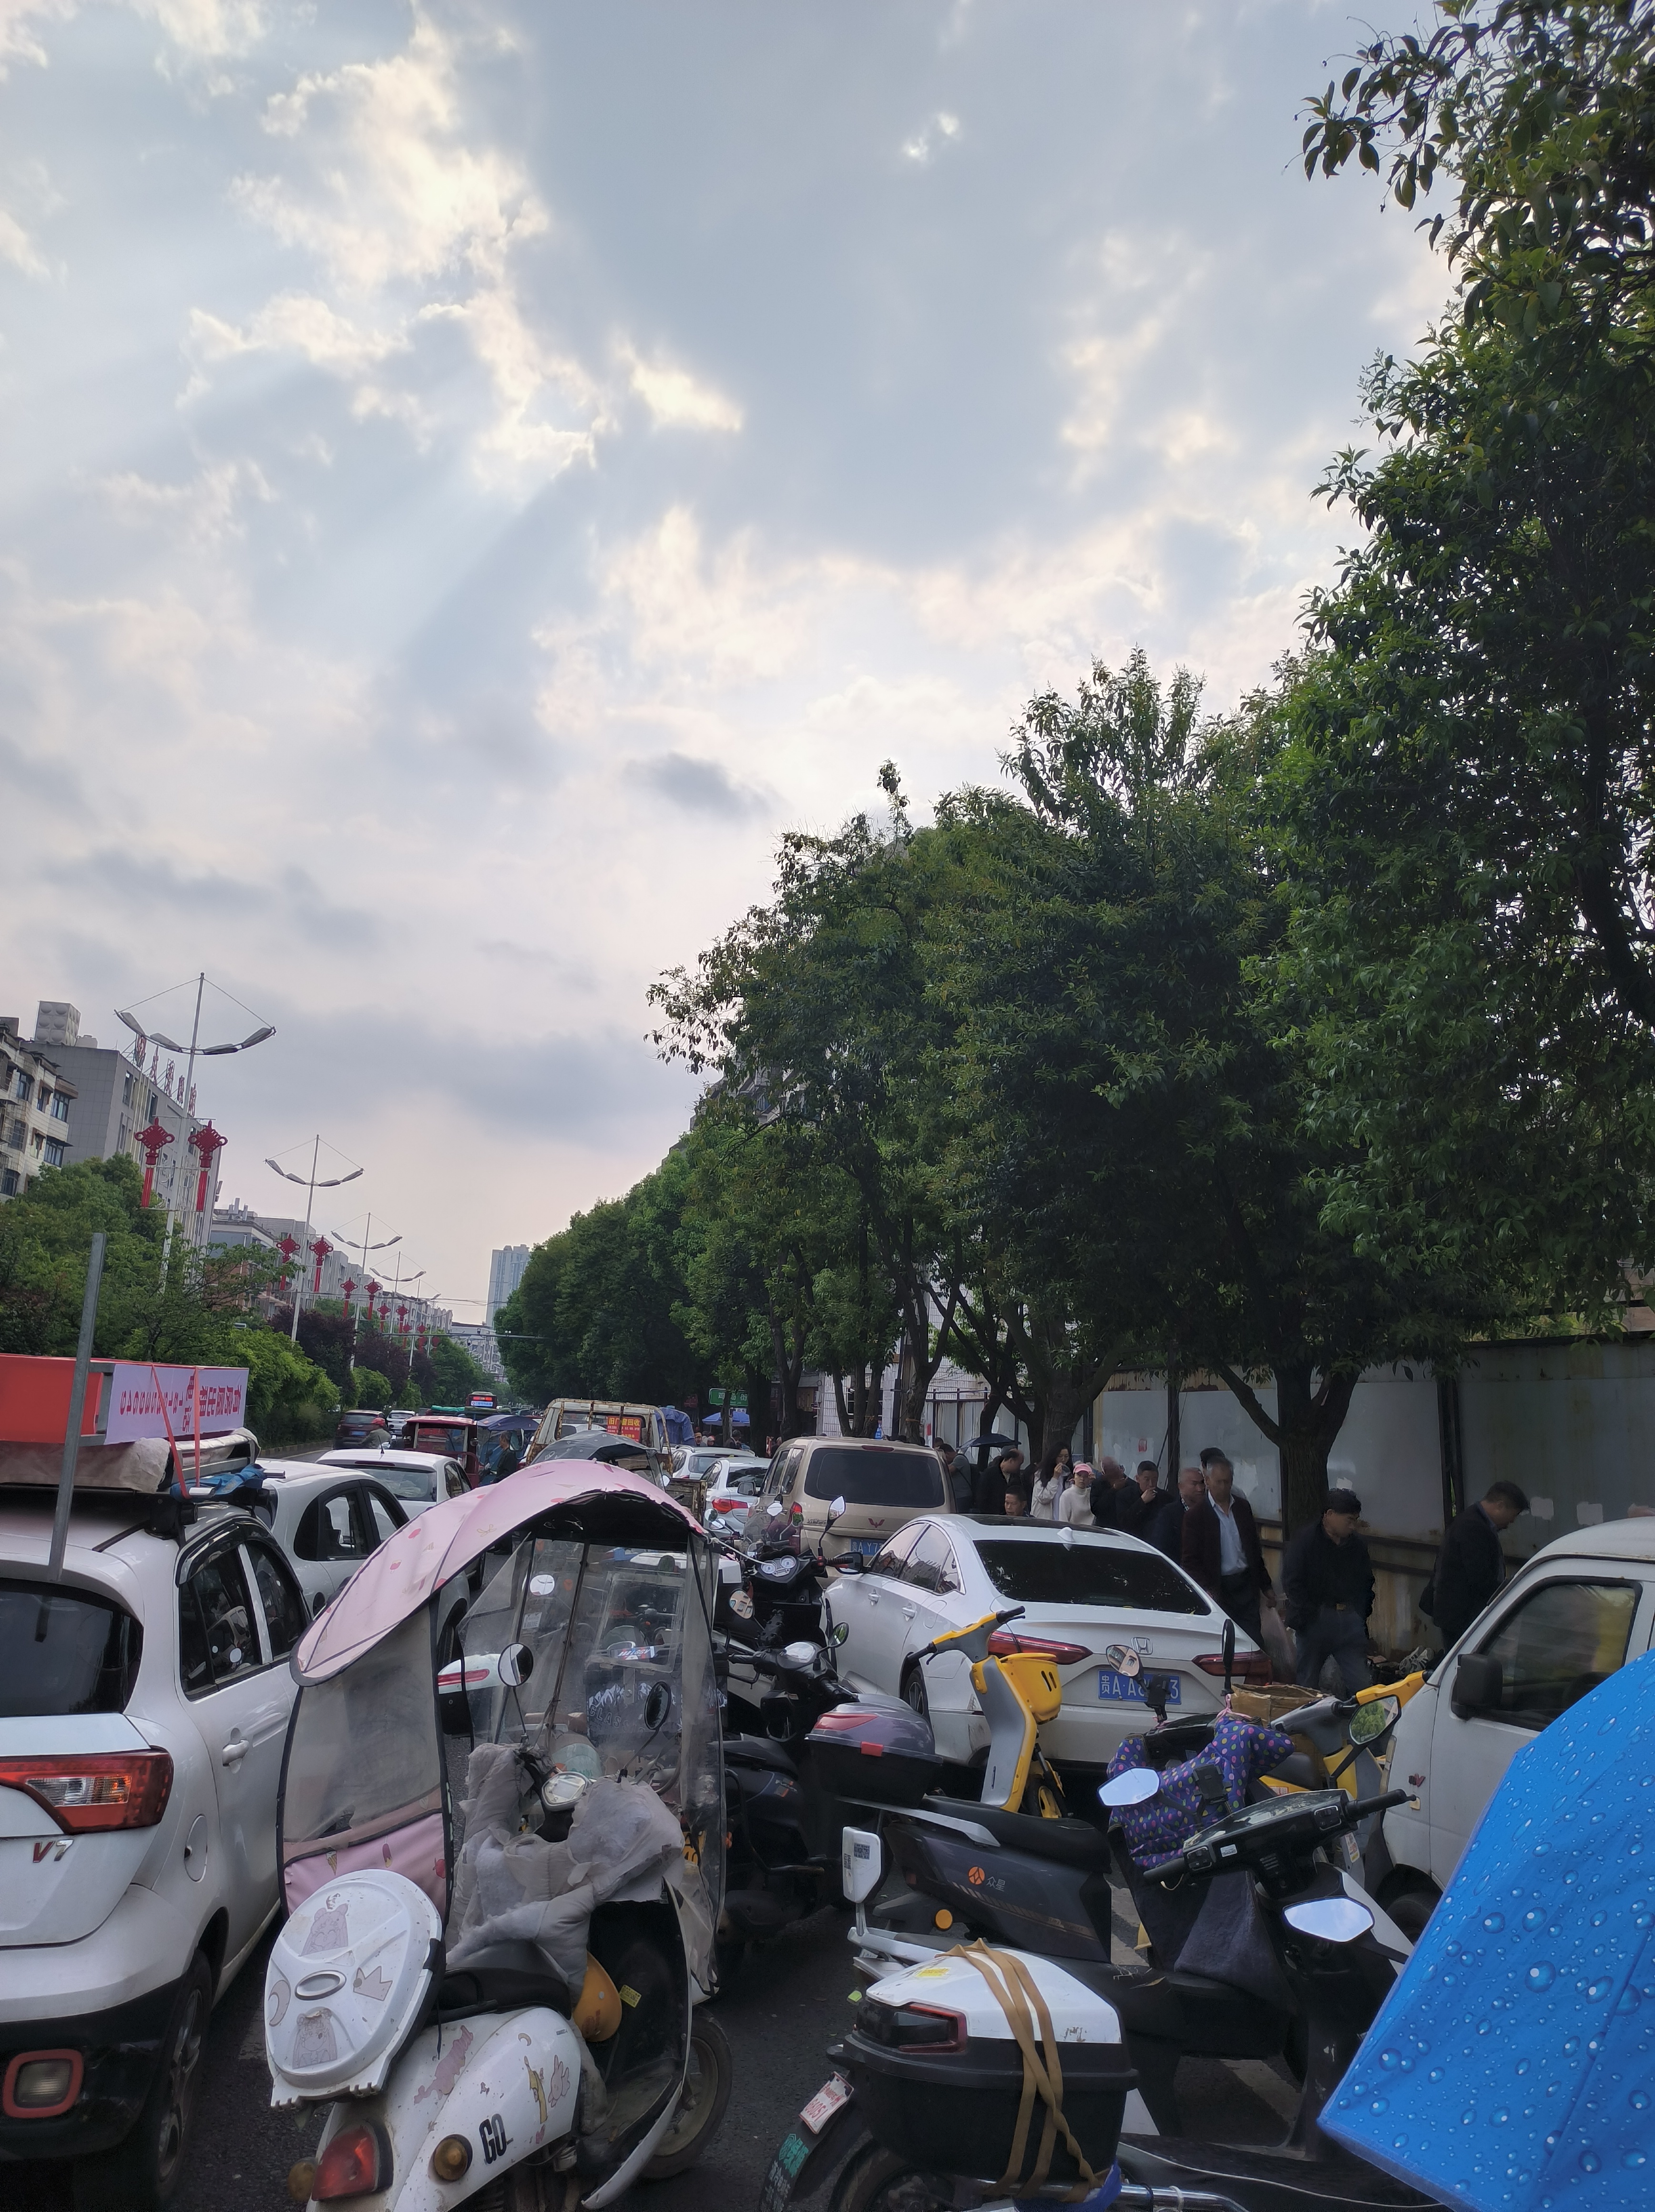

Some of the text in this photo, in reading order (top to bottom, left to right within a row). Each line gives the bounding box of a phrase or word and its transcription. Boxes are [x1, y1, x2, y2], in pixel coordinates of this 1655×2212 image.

[182, 1375, 194, 1433] 电话
[199, 1384, 242, 1417] 有房屋出租
[33, 1839, 74, 1863] V7
[986, 1876, 1006, 1892] 众星
